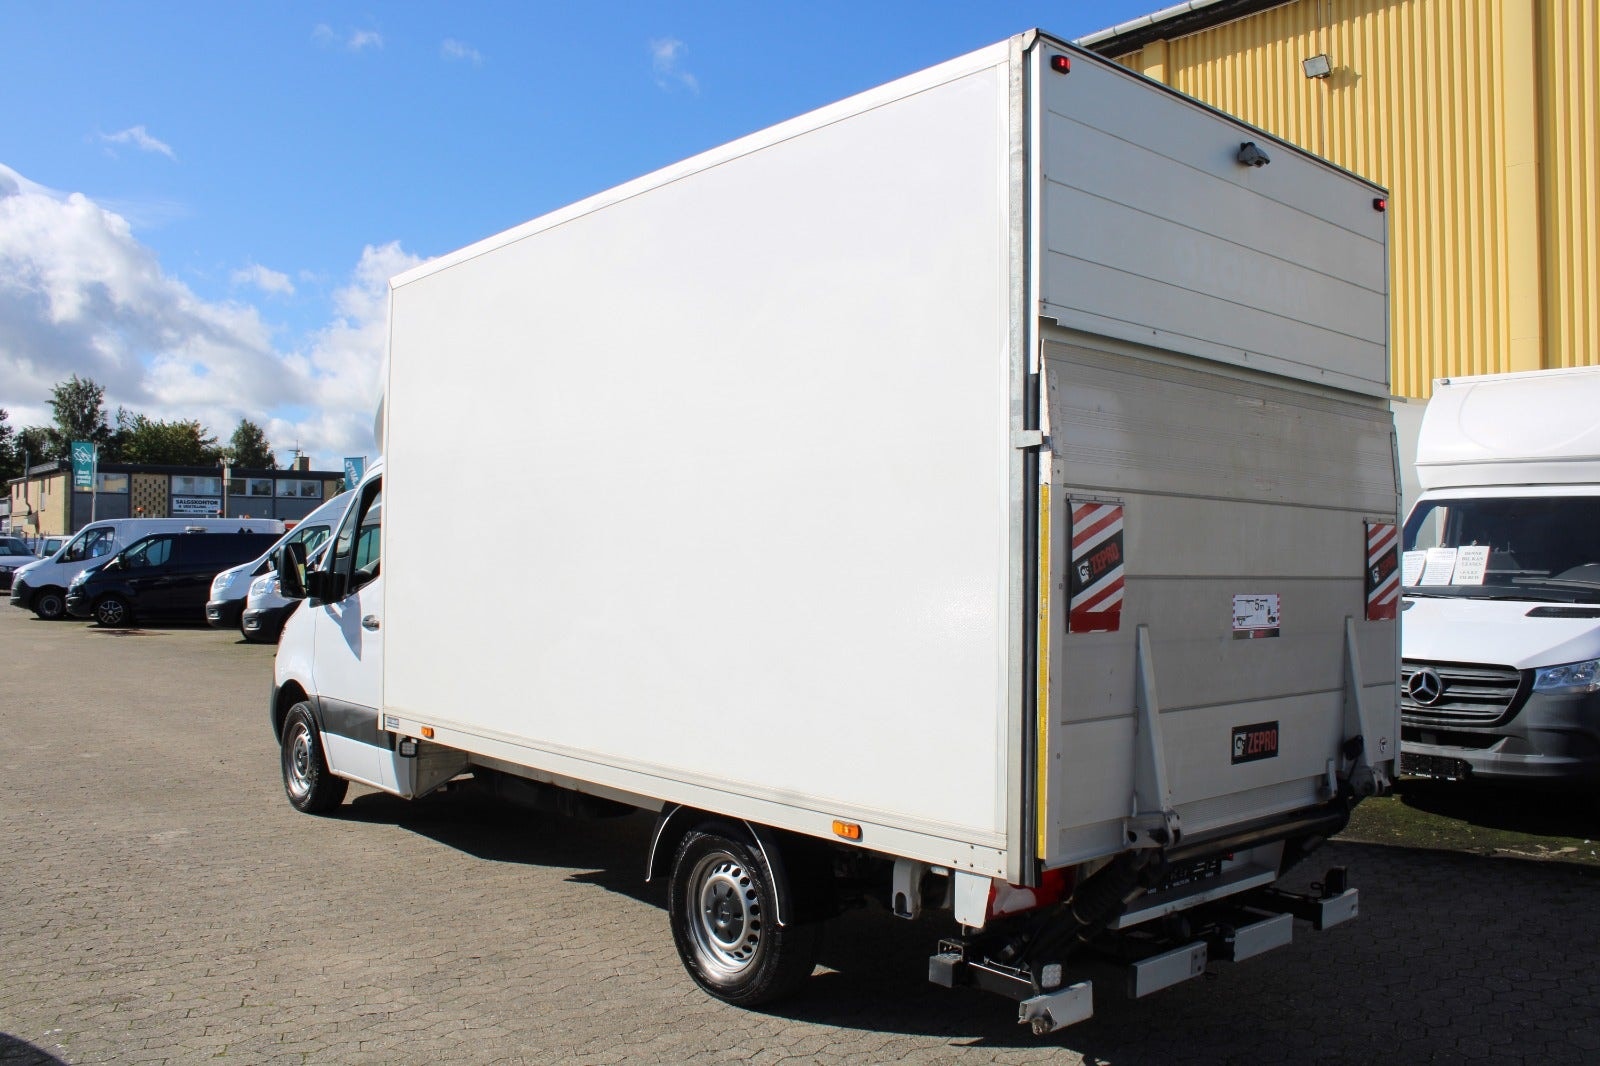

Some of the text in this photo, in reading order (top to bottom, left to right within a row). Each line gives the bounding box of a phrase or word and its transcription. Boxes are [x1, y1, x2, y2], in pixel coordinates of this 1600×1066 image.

[1091, 543, 1120, 574] ZEPRO
[1254, 598, 1265, 611] 5m
[1247, 730, 1277, 754] ZEPRO
